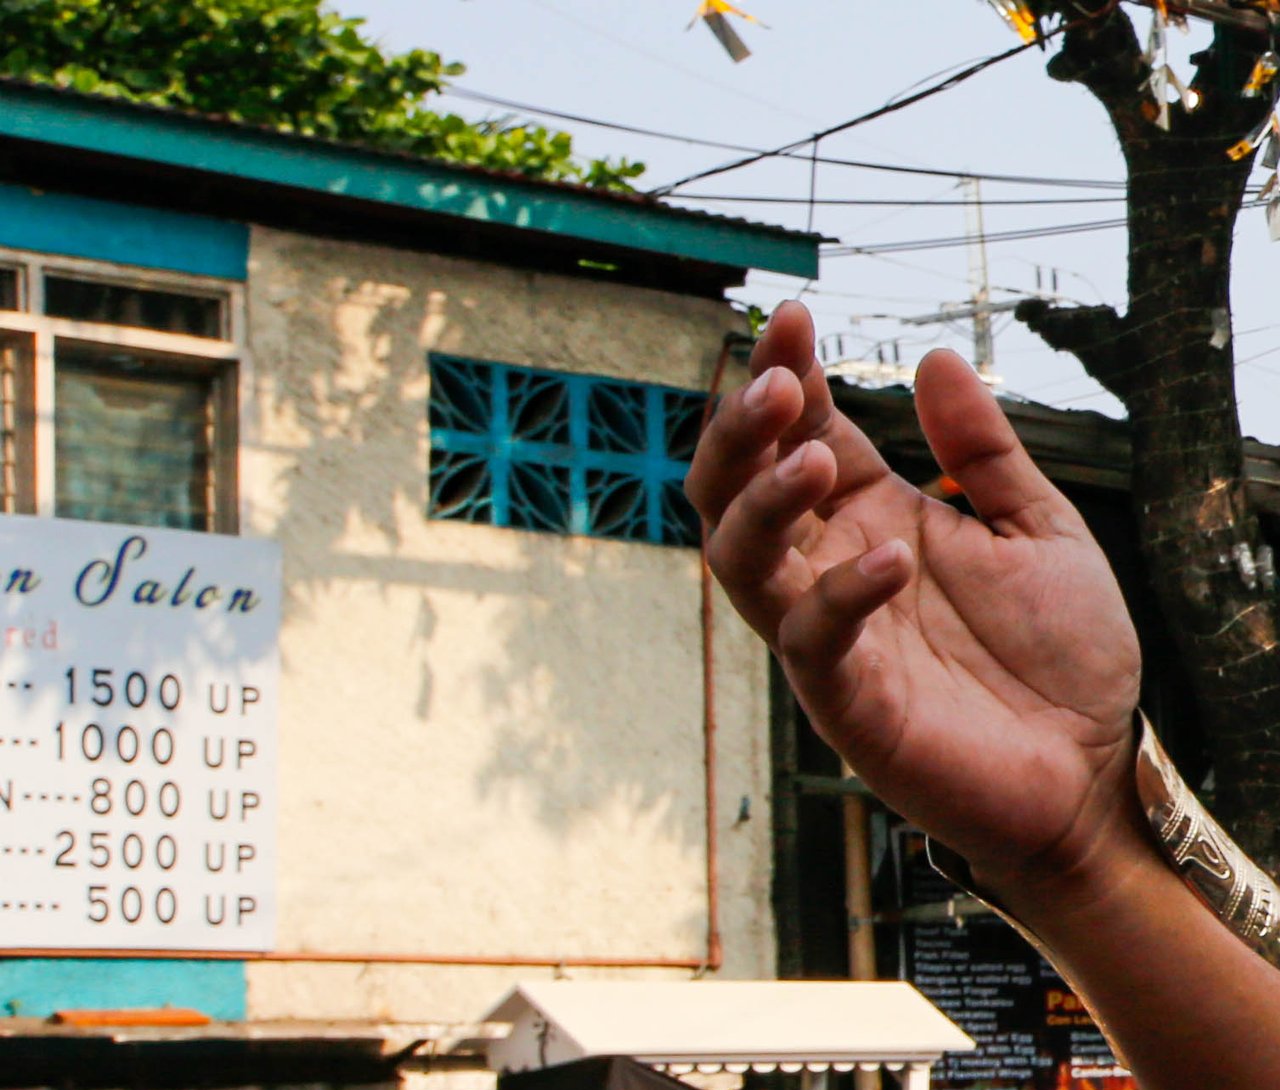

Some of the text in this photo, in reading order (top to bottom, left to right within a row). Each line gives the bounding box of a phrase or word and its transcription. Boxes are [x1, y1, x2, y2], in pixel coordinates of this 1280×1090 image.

[75, 535, 261, 612] Salon
[66, 666, 260, 715] 1500 UP
[56, 720, 257, 769] 1000 UP
[209, 788, 260, 822] UP
[54, 830, 256, 873] 2500 UP
[88, 885, 257, 927] 500 UP
